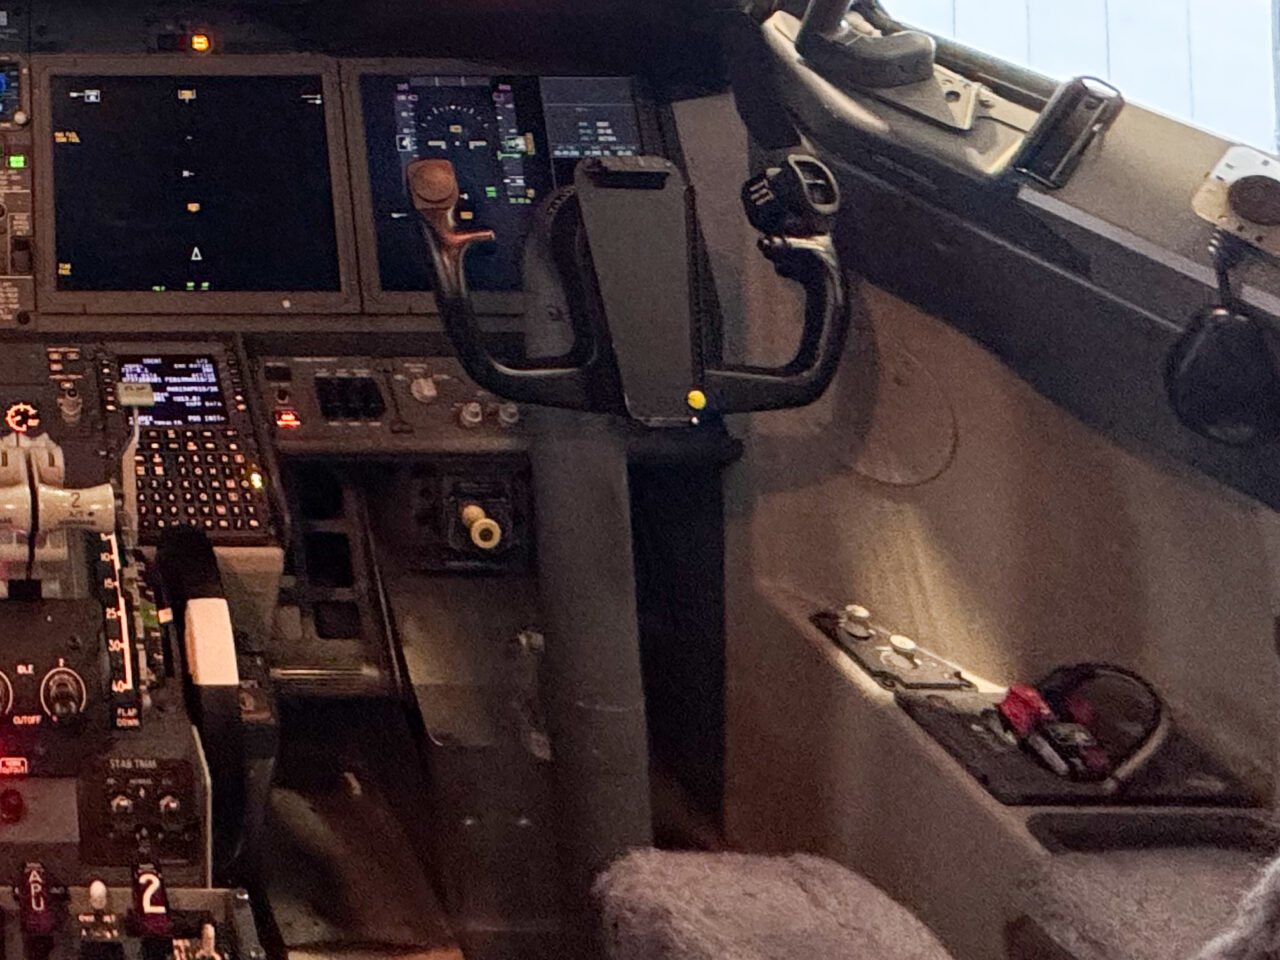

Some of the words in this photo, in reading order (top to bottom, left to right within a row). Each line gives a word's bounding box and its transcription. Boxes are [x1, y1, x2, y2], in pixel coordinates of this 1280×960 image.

[70, 492, 82, 507] 2
[108, 640, 120, 651] 30
[17, 665, 34, 674] IDLE
[112, 680, 126, 692] 40
[117, 707, 138, 718] FLAP
[12, 715, 42, 726] CUTOFF
[110, 759, 131, 769] STAB
[134, 759, 157, 769] TRIM
[27, 869, 45, 912] APU
[138, 872, 168, 914] 2
